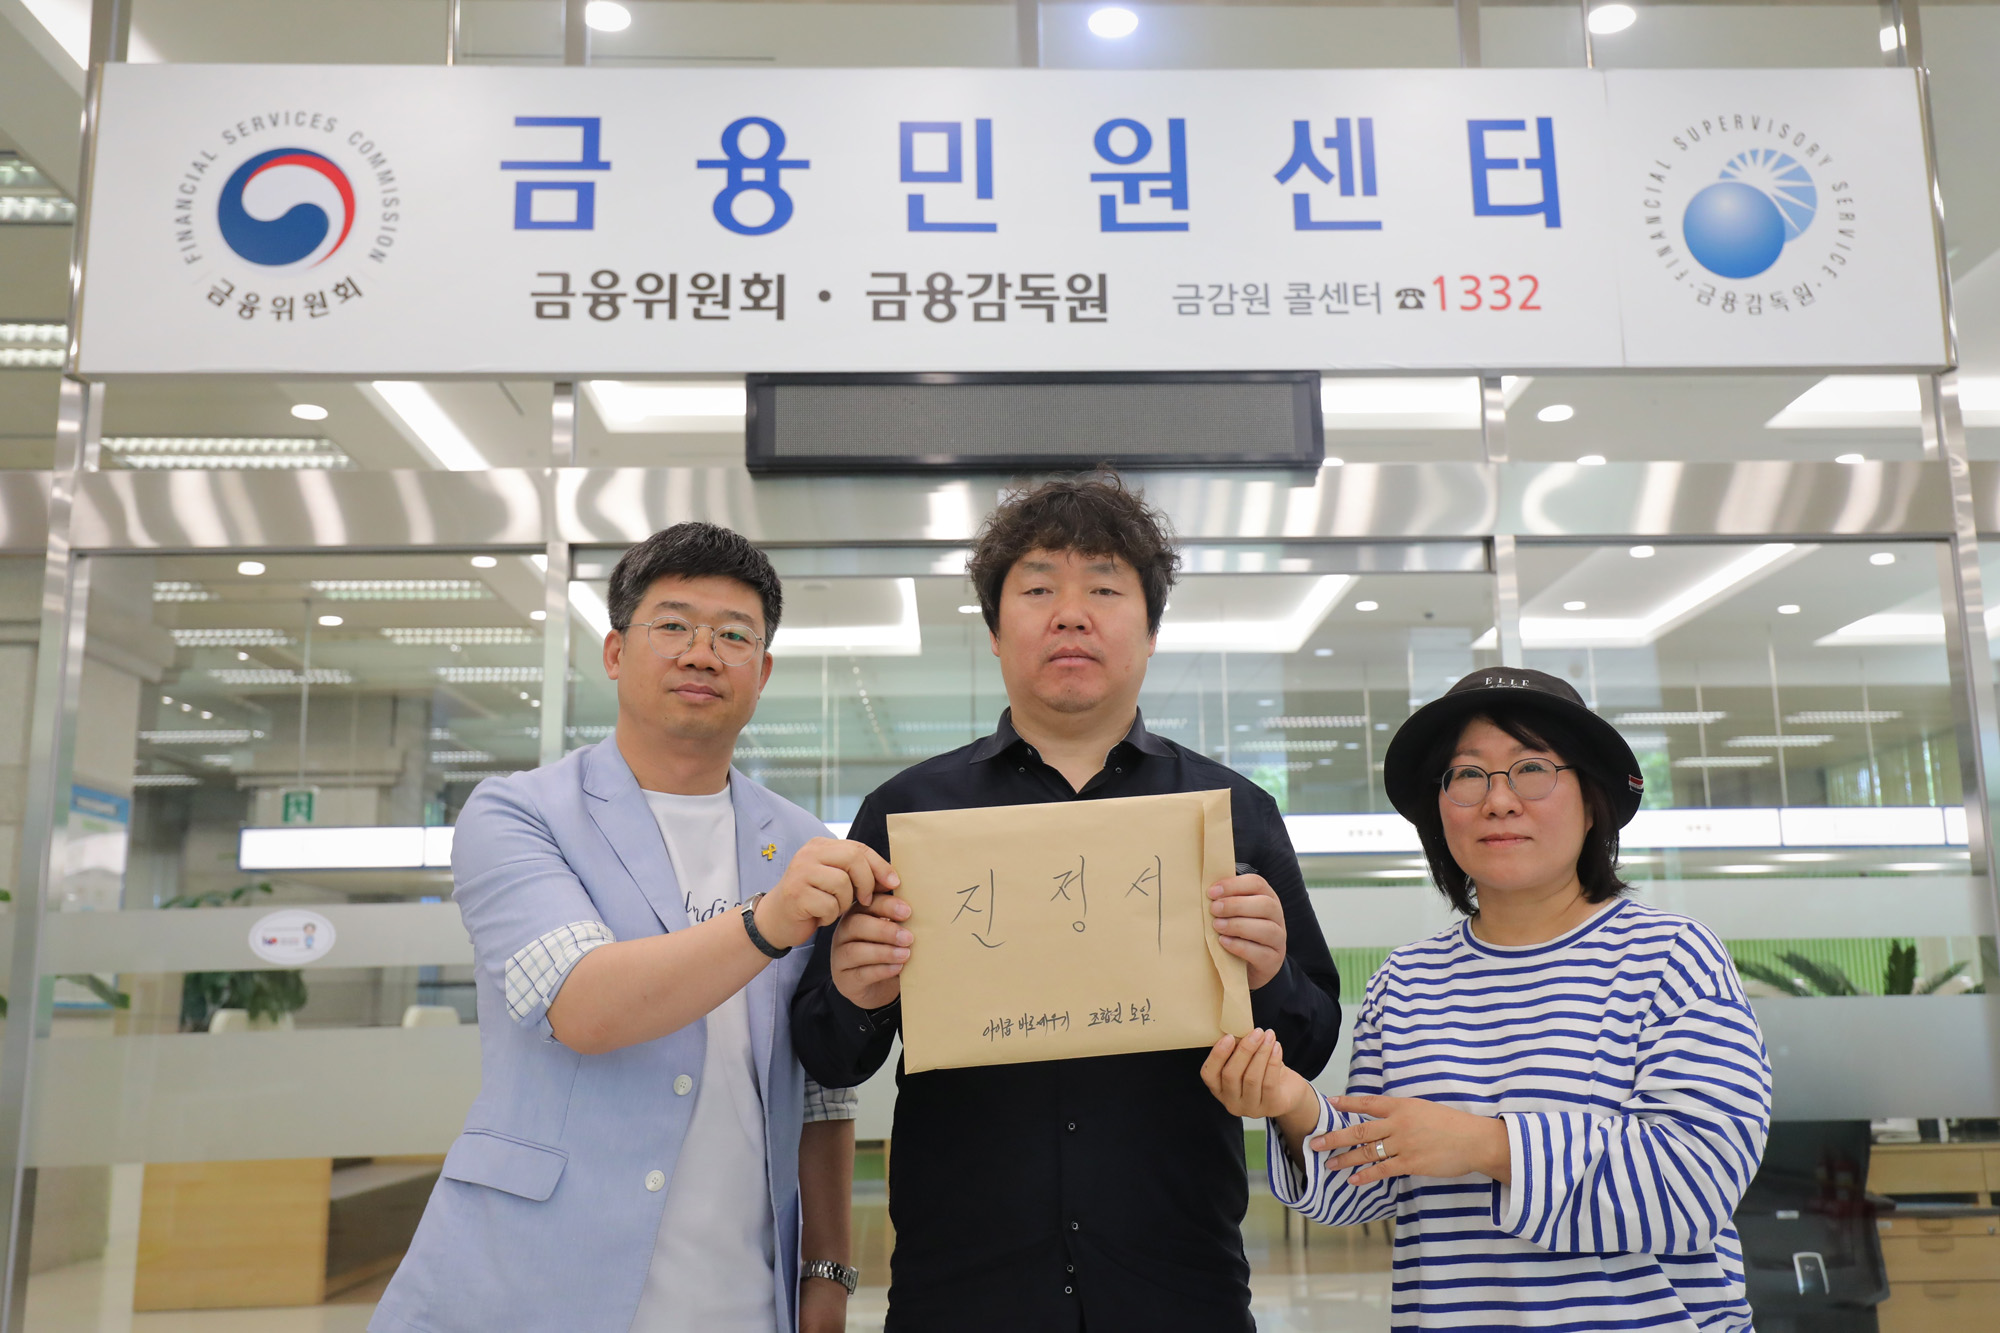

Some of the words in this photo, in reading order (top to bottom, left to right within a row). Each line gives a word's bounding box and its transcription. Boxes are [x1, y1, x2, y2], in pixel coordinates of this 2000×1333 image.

[175, 149, 218, 266] FINANCIAL
[221, 111, 338, 145] SERVICES
[348, 130, 400, 264] COMMISSION
[1643, 159, 1689, 282] FINANCIAL
[1673, 114, 1832, 168] SUPERVISORY
[1821, 180, 1856, 280] SERVICE
[206, 275, 364, 321] 금융위원회
[530, 269, 785, 321] 금융위원회
[866, 271, 1108, 322] 금융감독원
[1172, 281, 1271, 316] 금감원
[1284, 281, 1382, 316] 콜센터
[1432, 274, 1542, 312] 1332
[1696, 281, 1816, 316] 금융감독원
[1485, 676, 1530, 687] ELLE
